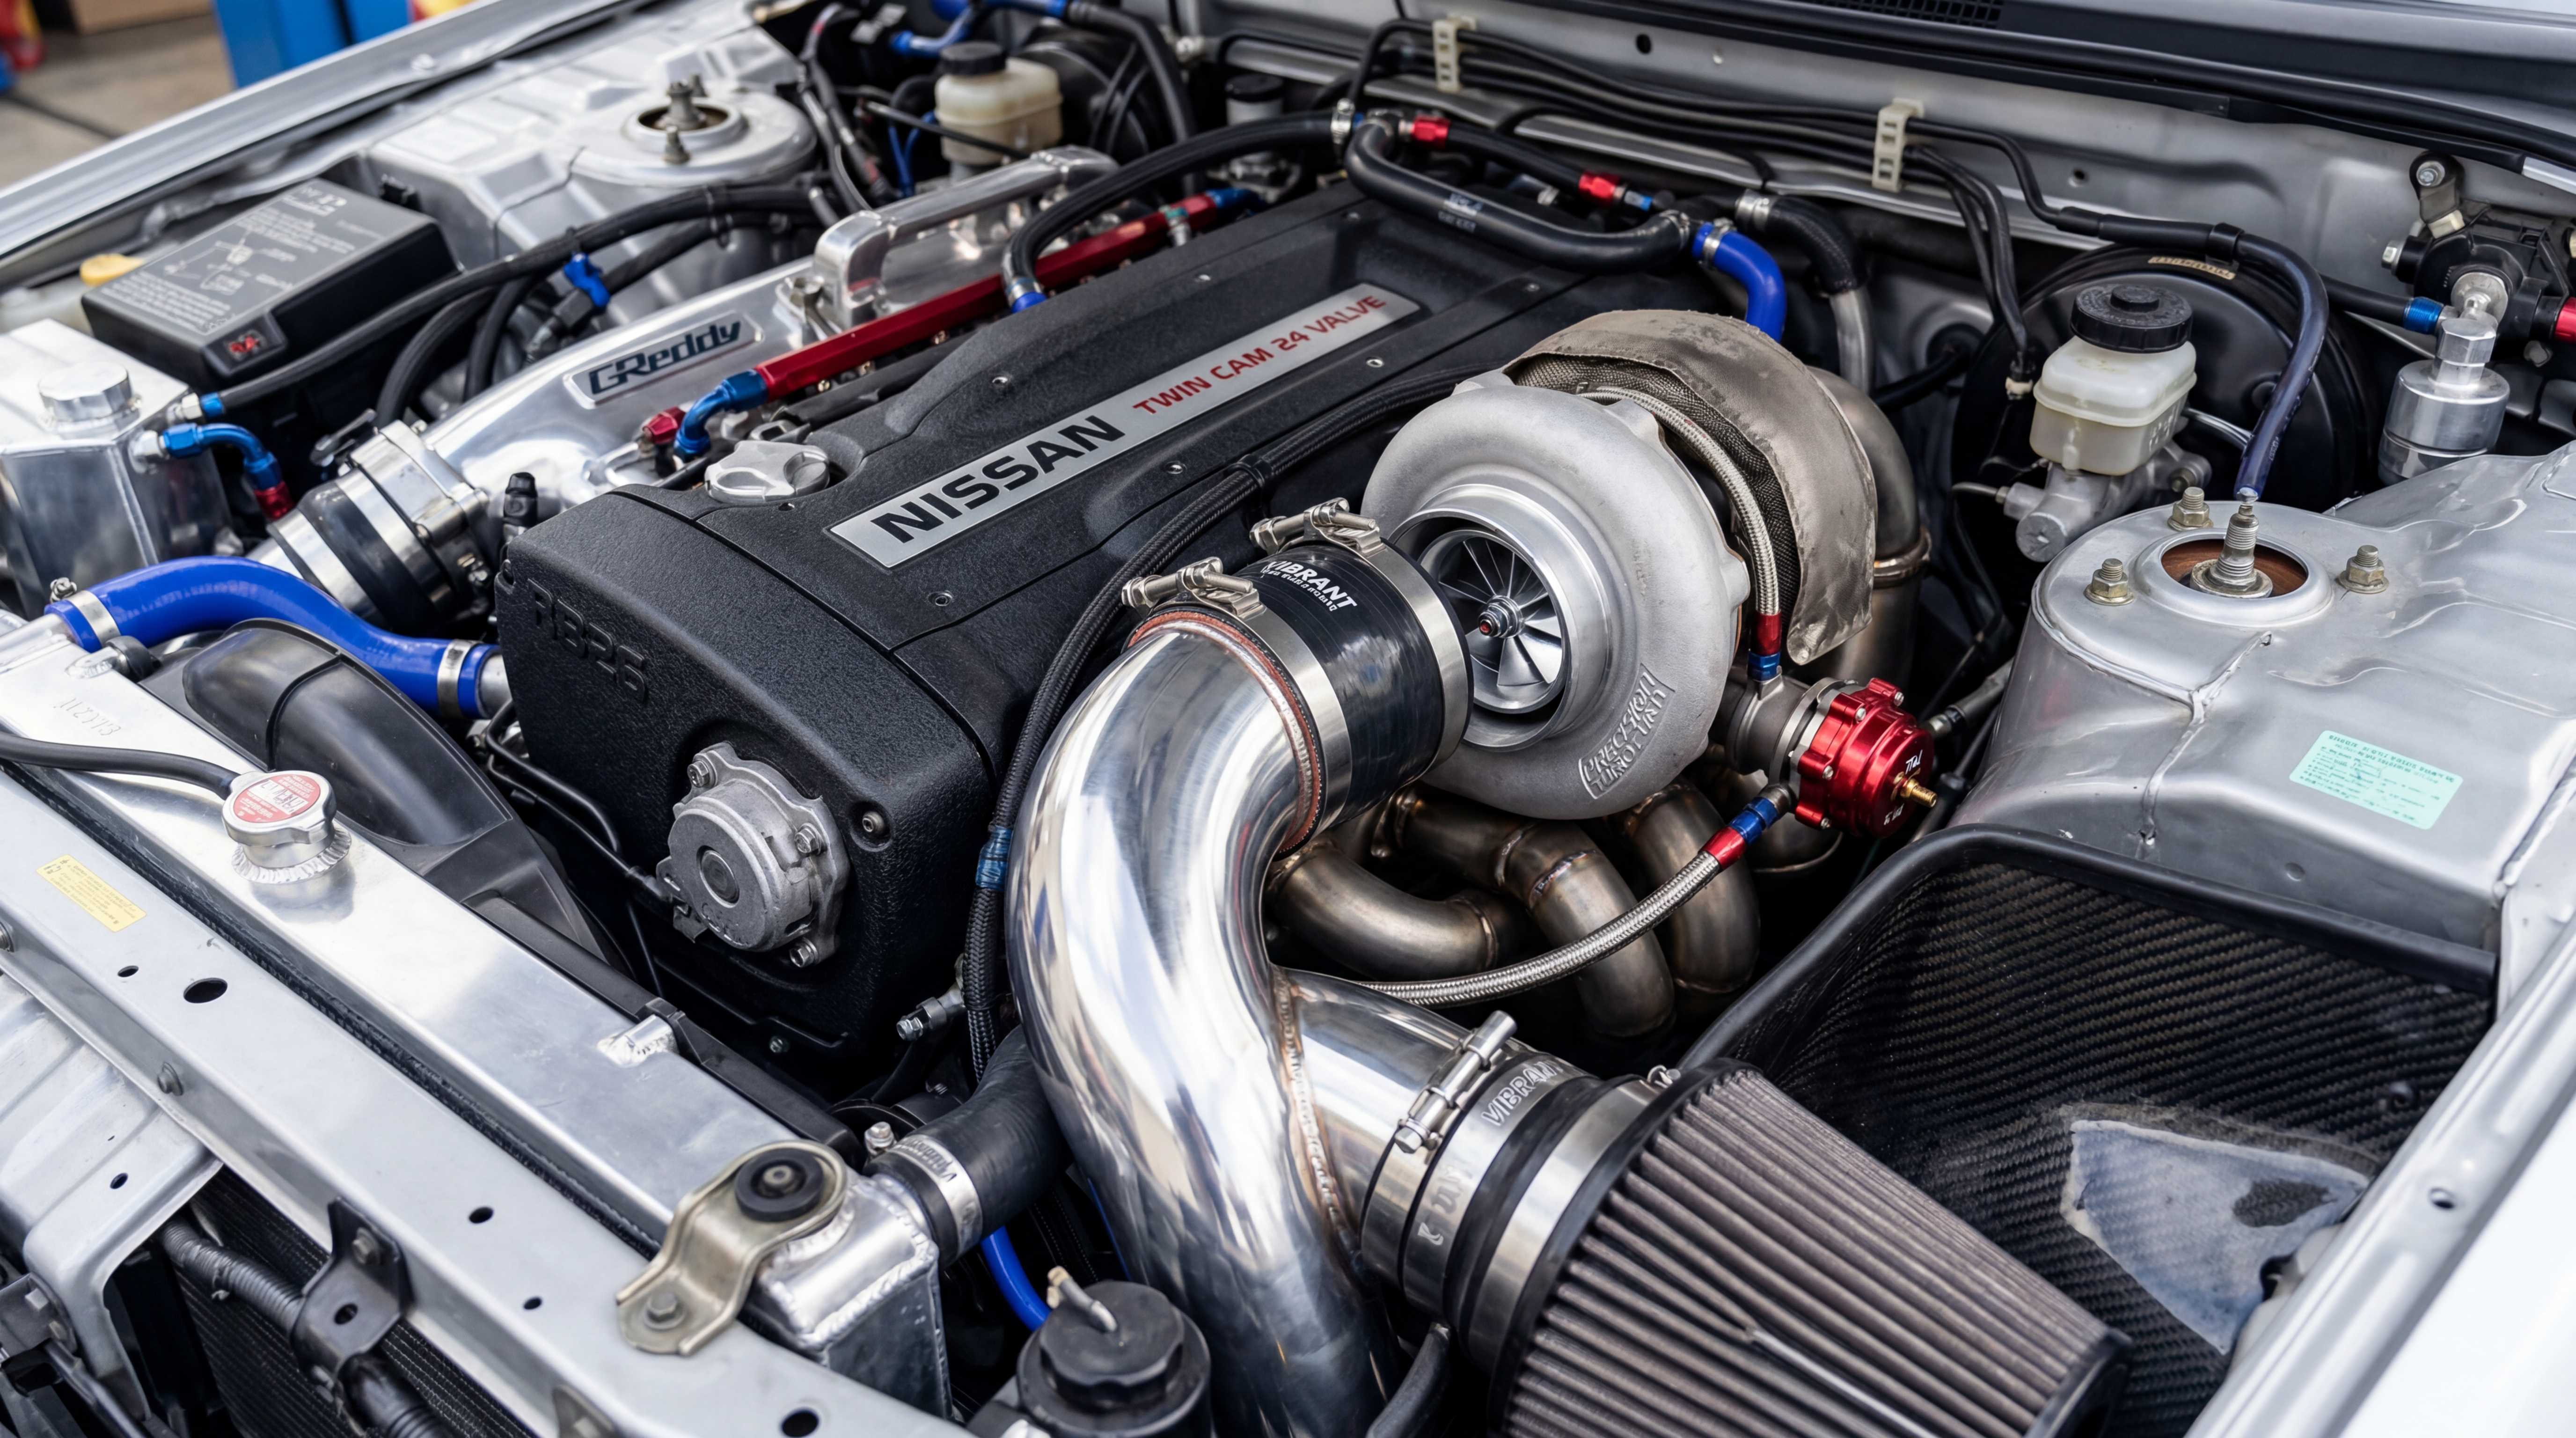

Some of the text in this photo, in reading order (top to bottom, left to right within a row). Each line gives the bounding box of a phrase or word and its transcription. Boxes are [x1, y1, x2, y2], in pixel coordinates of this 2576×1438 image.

[589, 322, 741, 394] GReddy
[1133, 295, 1386, 414] TWIN CAM 24 VALVE
[871, 415, 1126, 543] NISSAN
[1260, 561, 1358, 608] VIBRANT
